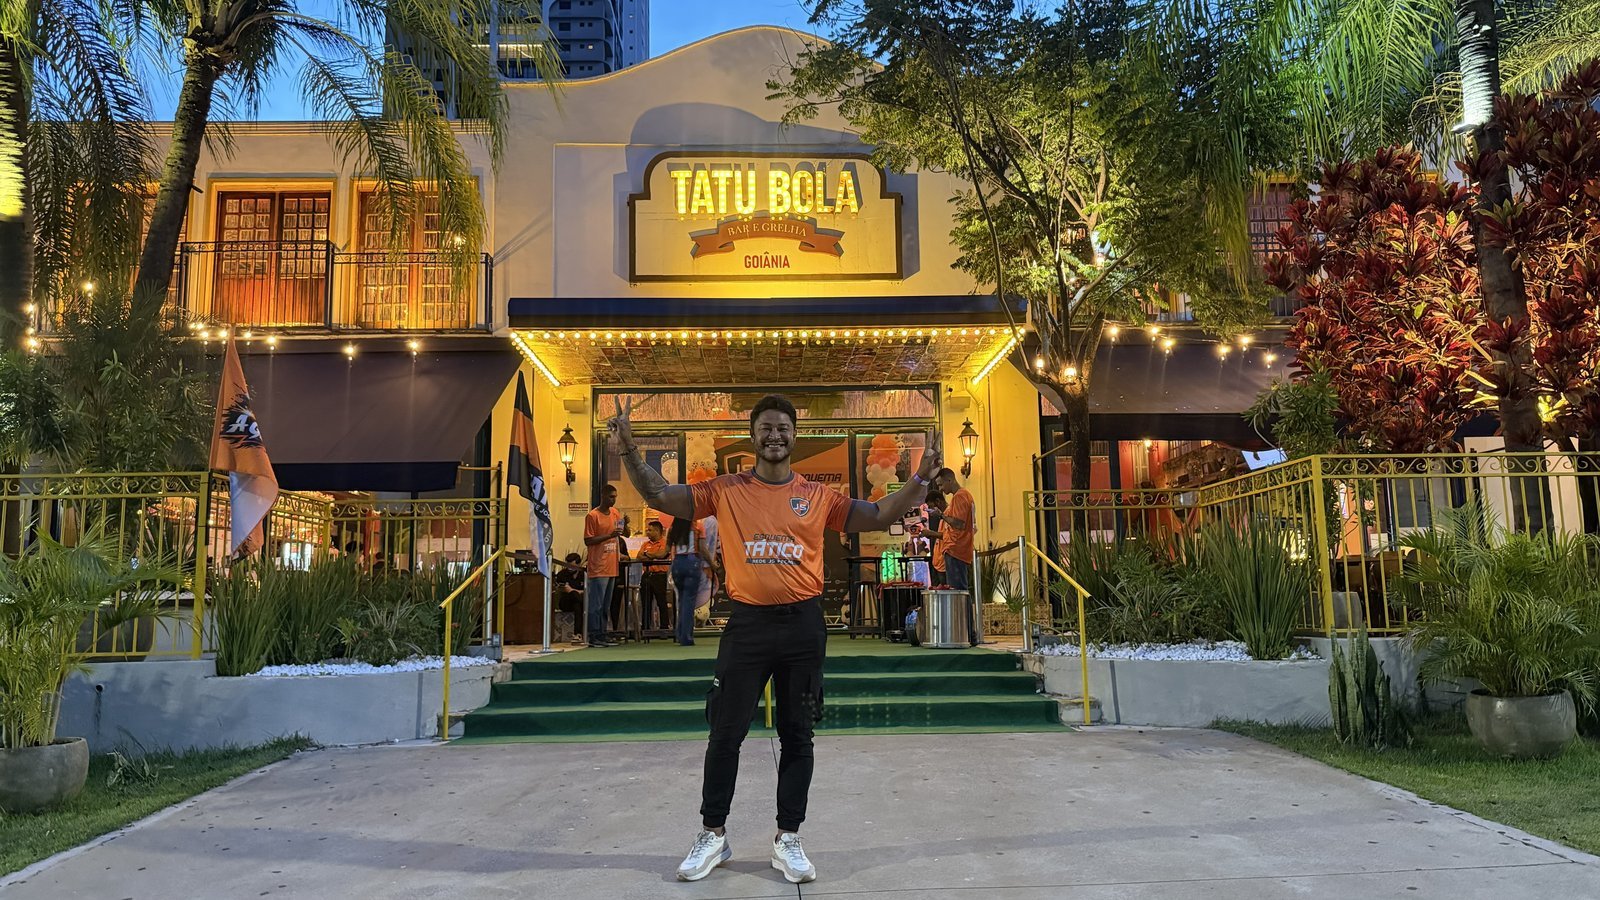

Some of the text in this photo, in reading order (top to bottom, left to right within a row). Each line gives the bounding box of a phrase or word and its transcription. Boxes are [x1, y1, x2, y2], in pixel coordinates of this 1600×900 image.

[670, 169, 859, 215] TATU BOLA
[728, 222, 807, 237] BAR E GRELHA
[744, 251, 790, 269] GOIÂNIA
[793, 503, 807, 511] JS
[754, 534, 795, 542] ESQUEMA
[744, 539, 805, 559] TÁTICO
